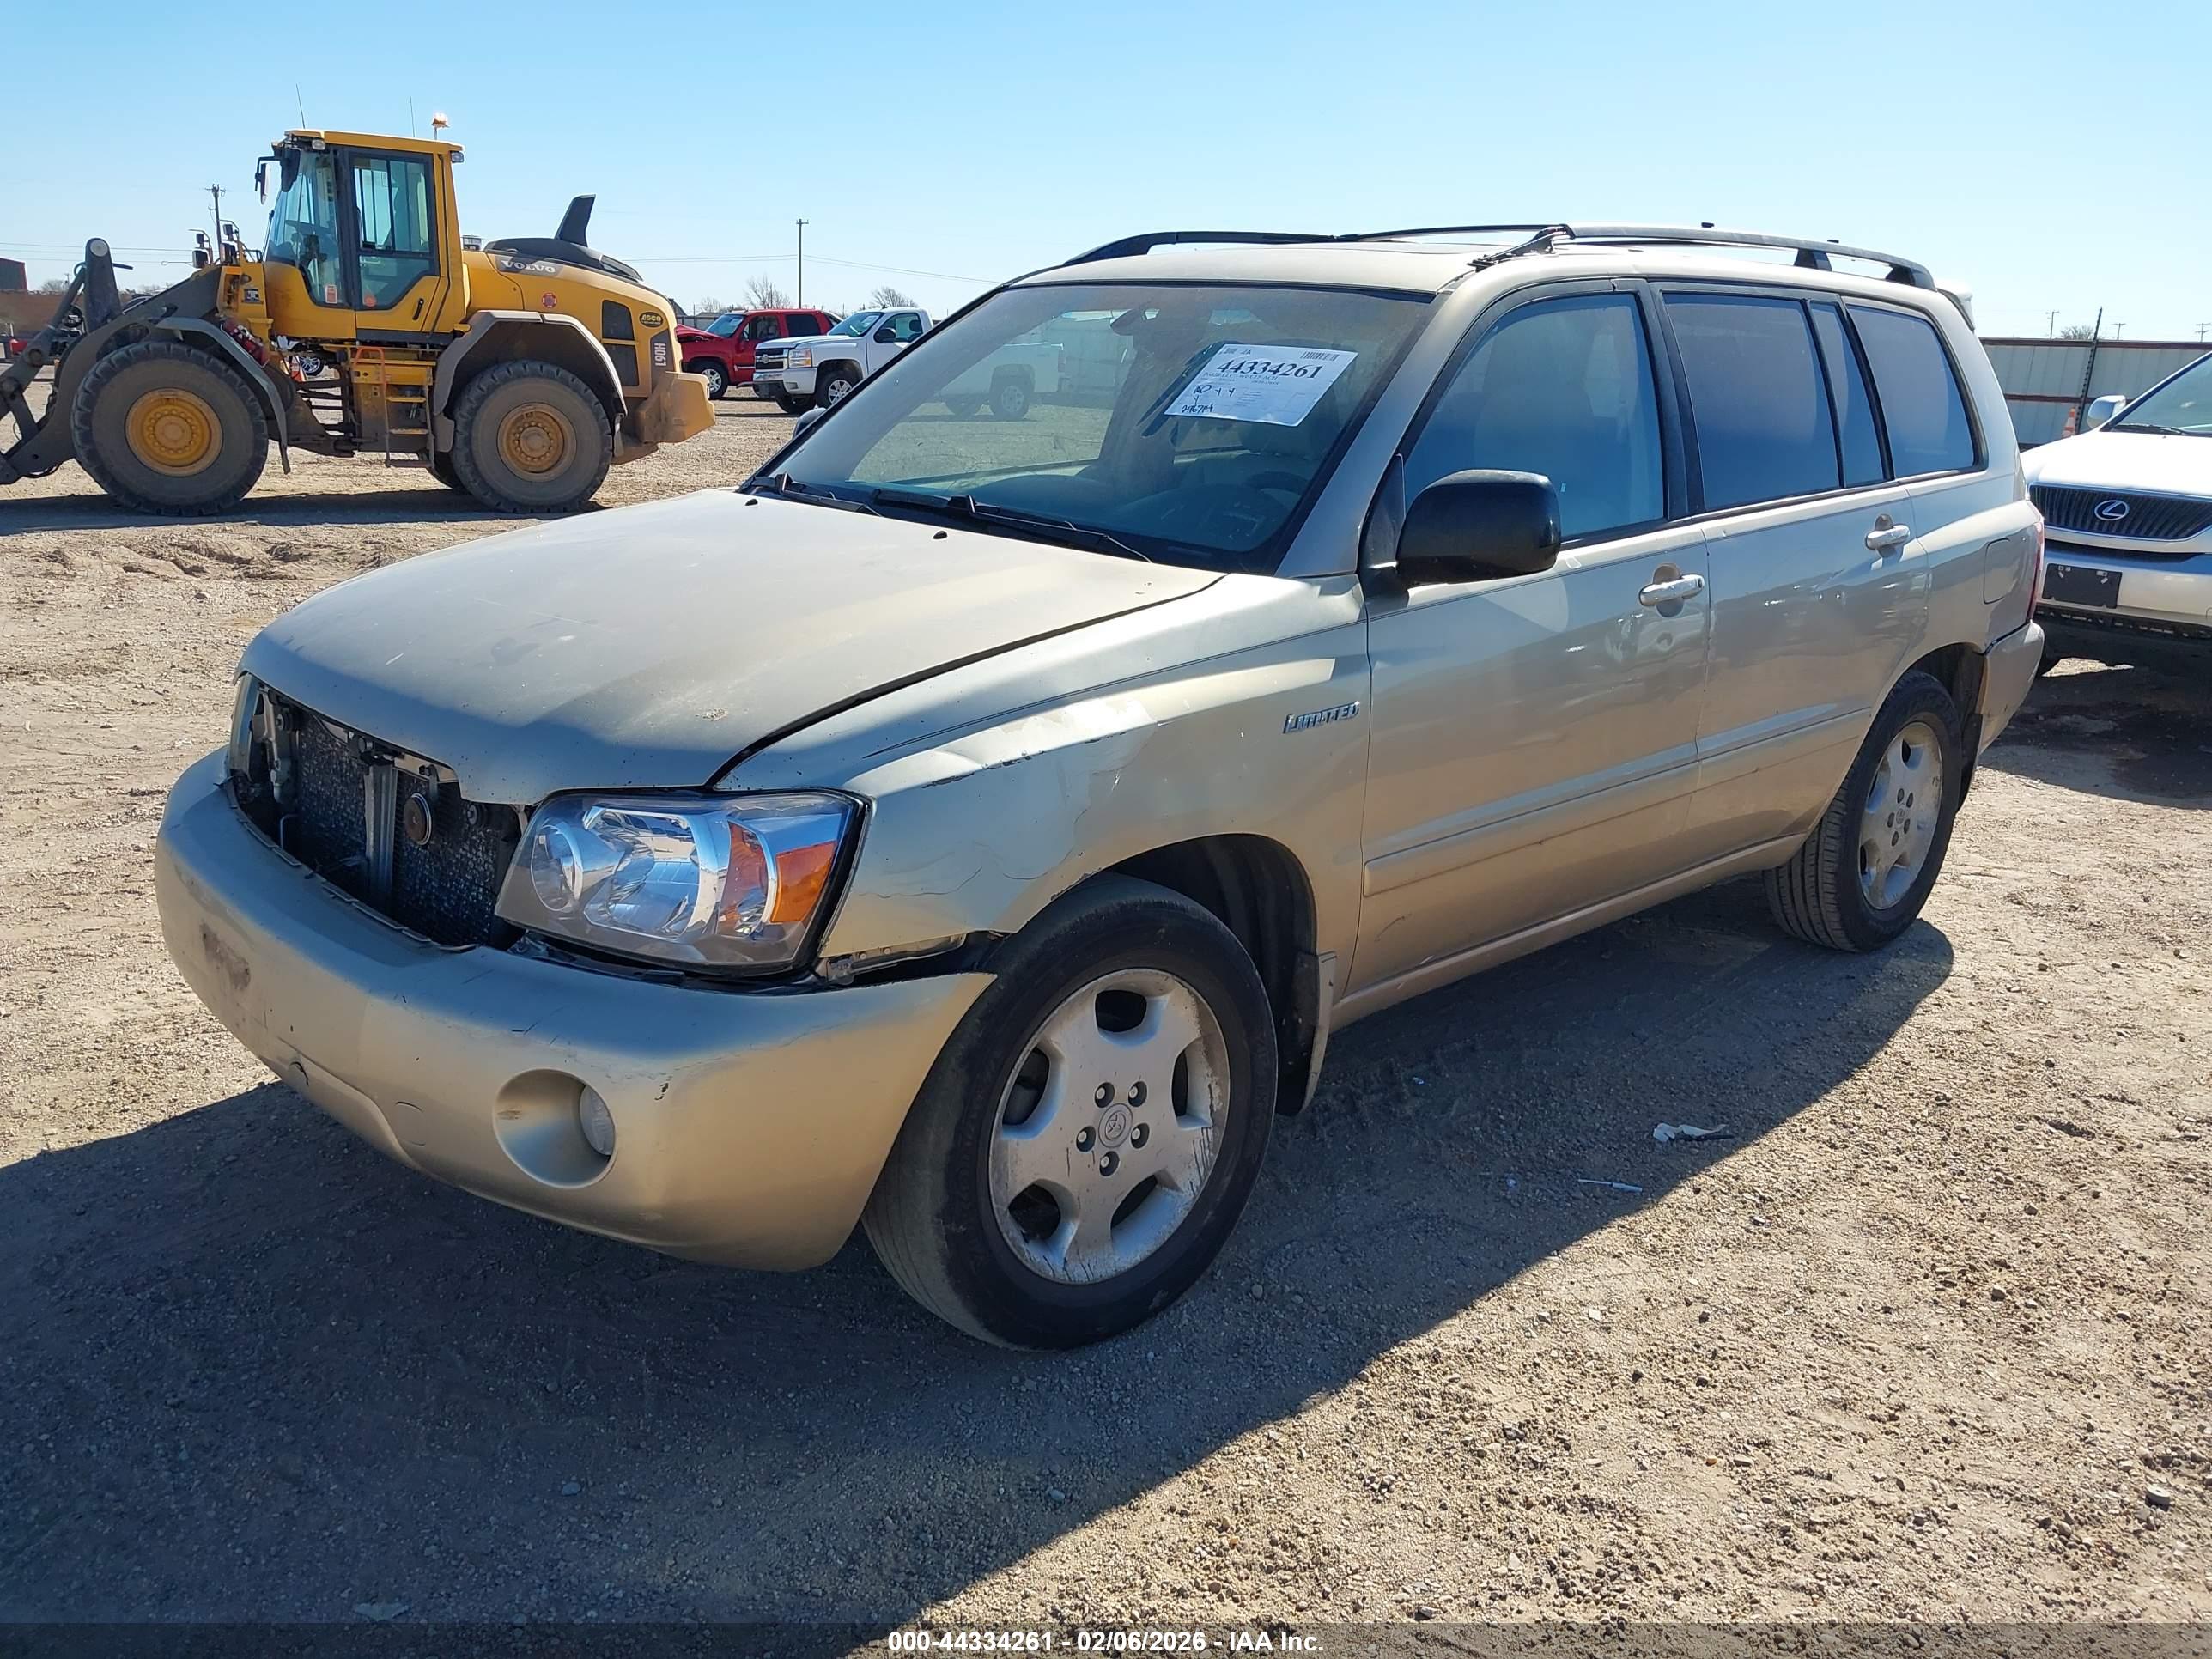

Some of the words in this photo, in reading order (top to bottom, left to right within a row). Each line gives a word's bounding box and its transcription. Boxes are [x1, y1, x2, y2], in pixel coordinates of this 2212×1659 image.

[501, 260, 556, 273] VOLVO
[654, 343, 667, 367] L90H
[1217, 358, 1323, 380] 44334261
[1282, 701, 1361, 734] LIMITED
